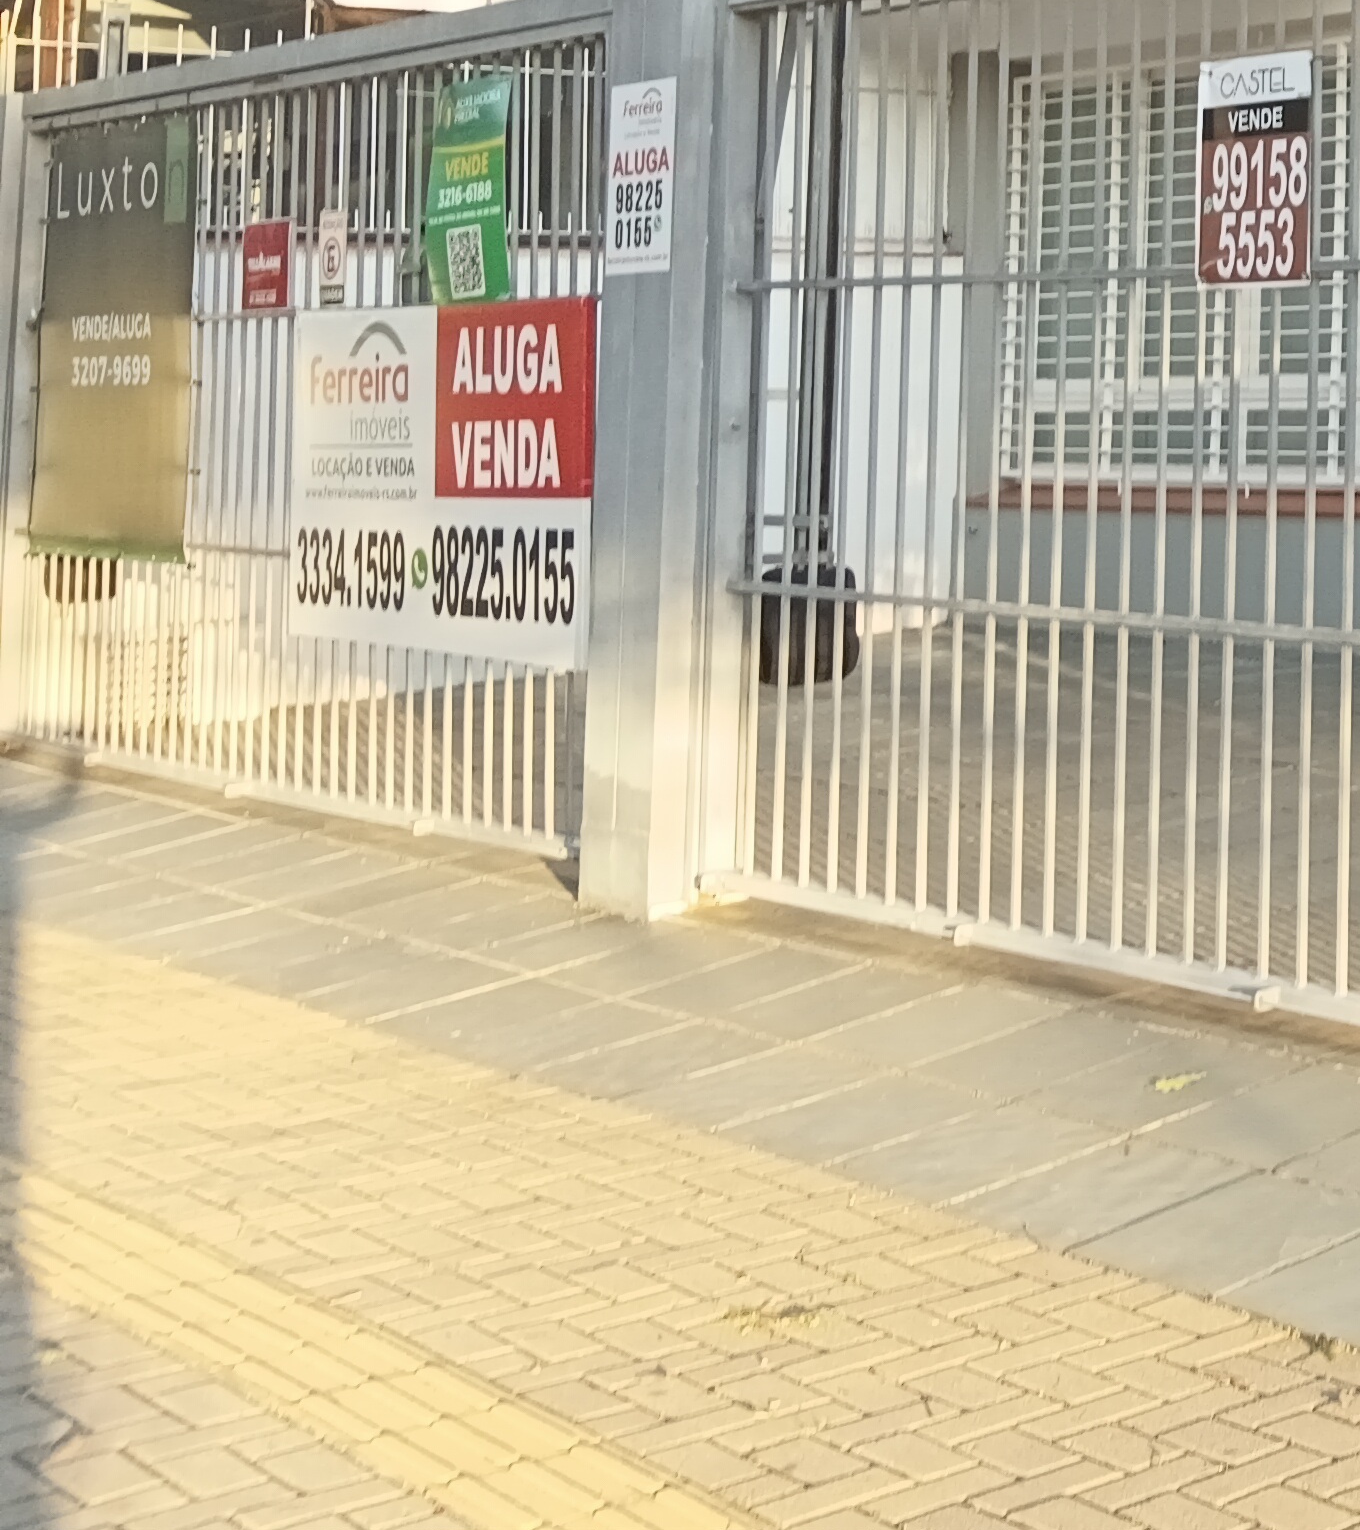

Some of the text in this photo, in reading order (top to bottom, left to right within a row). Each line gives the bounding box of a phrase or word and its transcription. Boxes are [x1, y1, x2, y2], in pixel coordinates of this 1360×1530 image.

[1219, 66, 1296, 99] CASTEL
[623, 97, 663, 117] Ferreira
[1227, 105, 1284, 133] VENDE
[445, 151, 489, 182] VENDE
[612, 145, 670, 178] ALUGA
[1212, 135, 1307, 212] 99158
[616, 178, 663, 214] 98225
[615, 216, 652, 249] 0155
[1216, 207, 1294, 280] 5553
[72, 312, 151, 342] VENDE/ALUGA
[71, 354, 151, 387] 3207-9699
[452, 323, 563, 395] ALUGA
[349, 408, 411, 441] imóveis
[312, 452, 415, 481] LOCAÇÃO E VENDA
[451, 417, 561, 489] VENDA
[297, 524, 575, 626] 3334.1599 98225.0155
